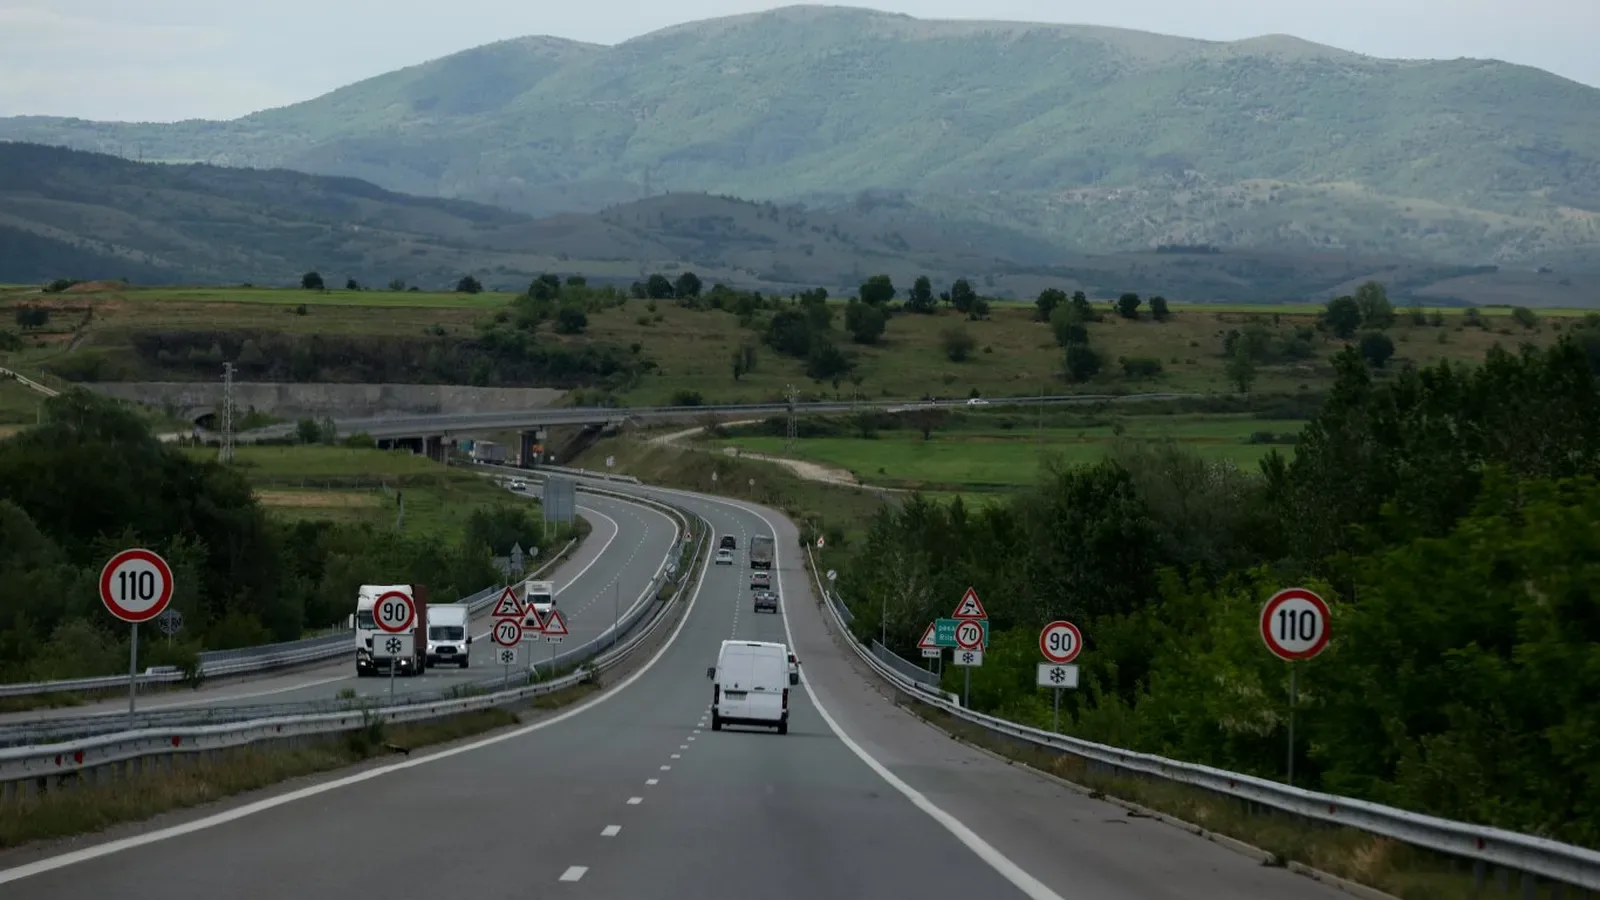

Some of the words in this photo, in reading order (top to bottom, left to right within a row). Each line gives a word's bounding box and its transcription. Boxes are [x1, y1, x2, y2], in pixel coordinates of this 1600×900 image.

[118, 570, 154, 601] 110
[383, 602, 405, 622] 90
[500, 625, 516, 640] 70
[962, 627, 977, 641] 70
[1278, 609, 1316, 642] 110
[1049, 632, 1072, 652] 90
